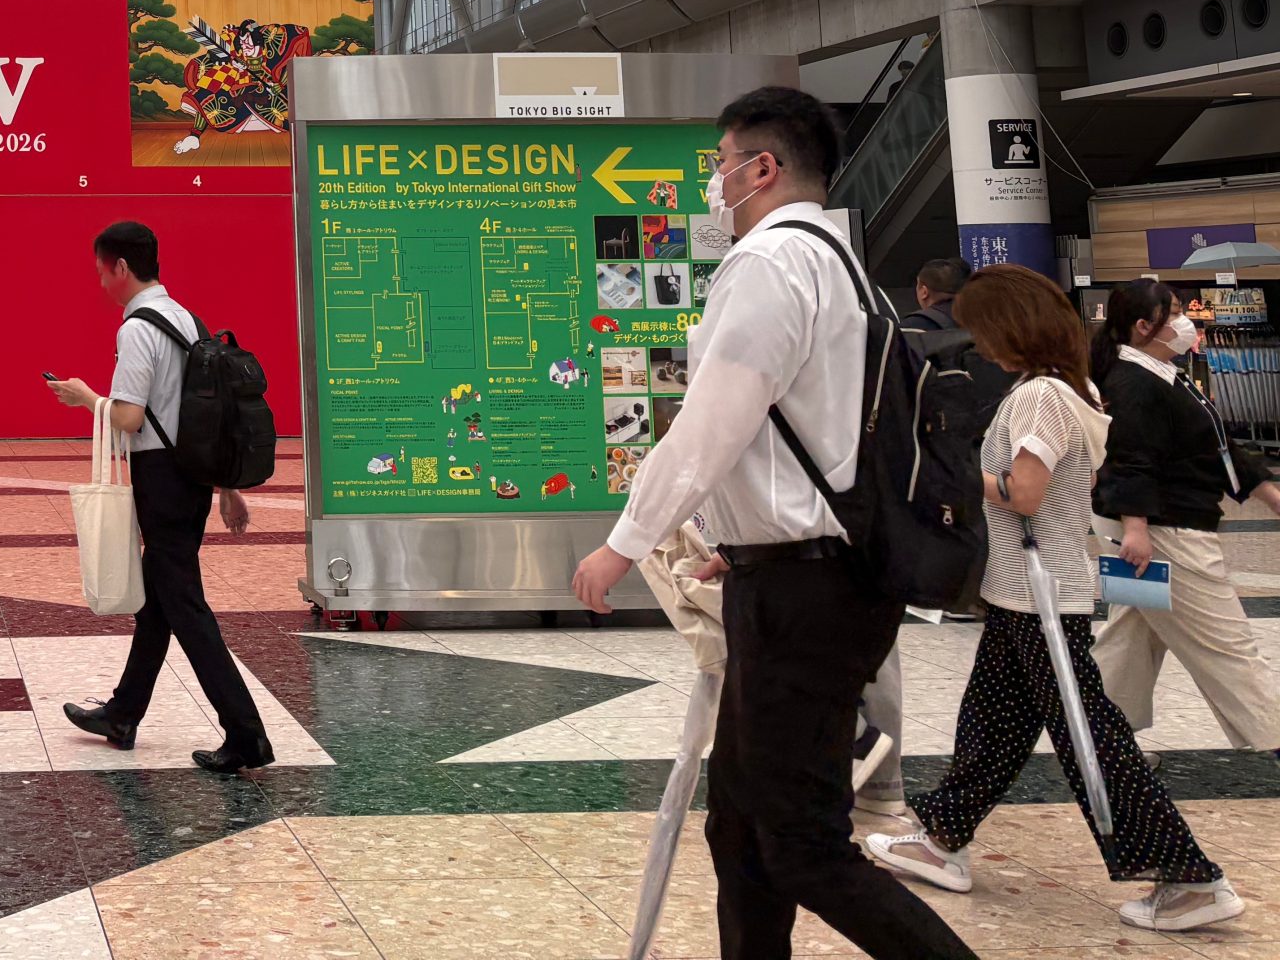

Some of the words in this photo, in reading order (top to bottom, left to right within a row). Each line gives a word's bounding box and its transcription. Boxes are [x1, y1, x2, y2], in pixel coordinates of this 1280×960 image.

[509, 106, 547, 116] TOKYO
[552, 106, 572, 116] BIG
[577, 106, 612, 116] SIGHT
[996, 123, 1033, 133] SERVICE
[78, 176, 88, 188] 5
[192, 175, 202, 187] 4
[319, 182, 344, 193] 20th
[347, 182, 386, 193] Edition
[395, 182, 409, 196] by
[412, 182, 445, 196] Tokyo
[448, 181, 520, 193] International
[522, 182, 542, 193] Gift
[545, 182, 577, 193] Show
[321, 218, 341, 234] 1F
[480, 217, 502, 234] 4F
[614, 333, 687, 343] デザイン・ものづく
